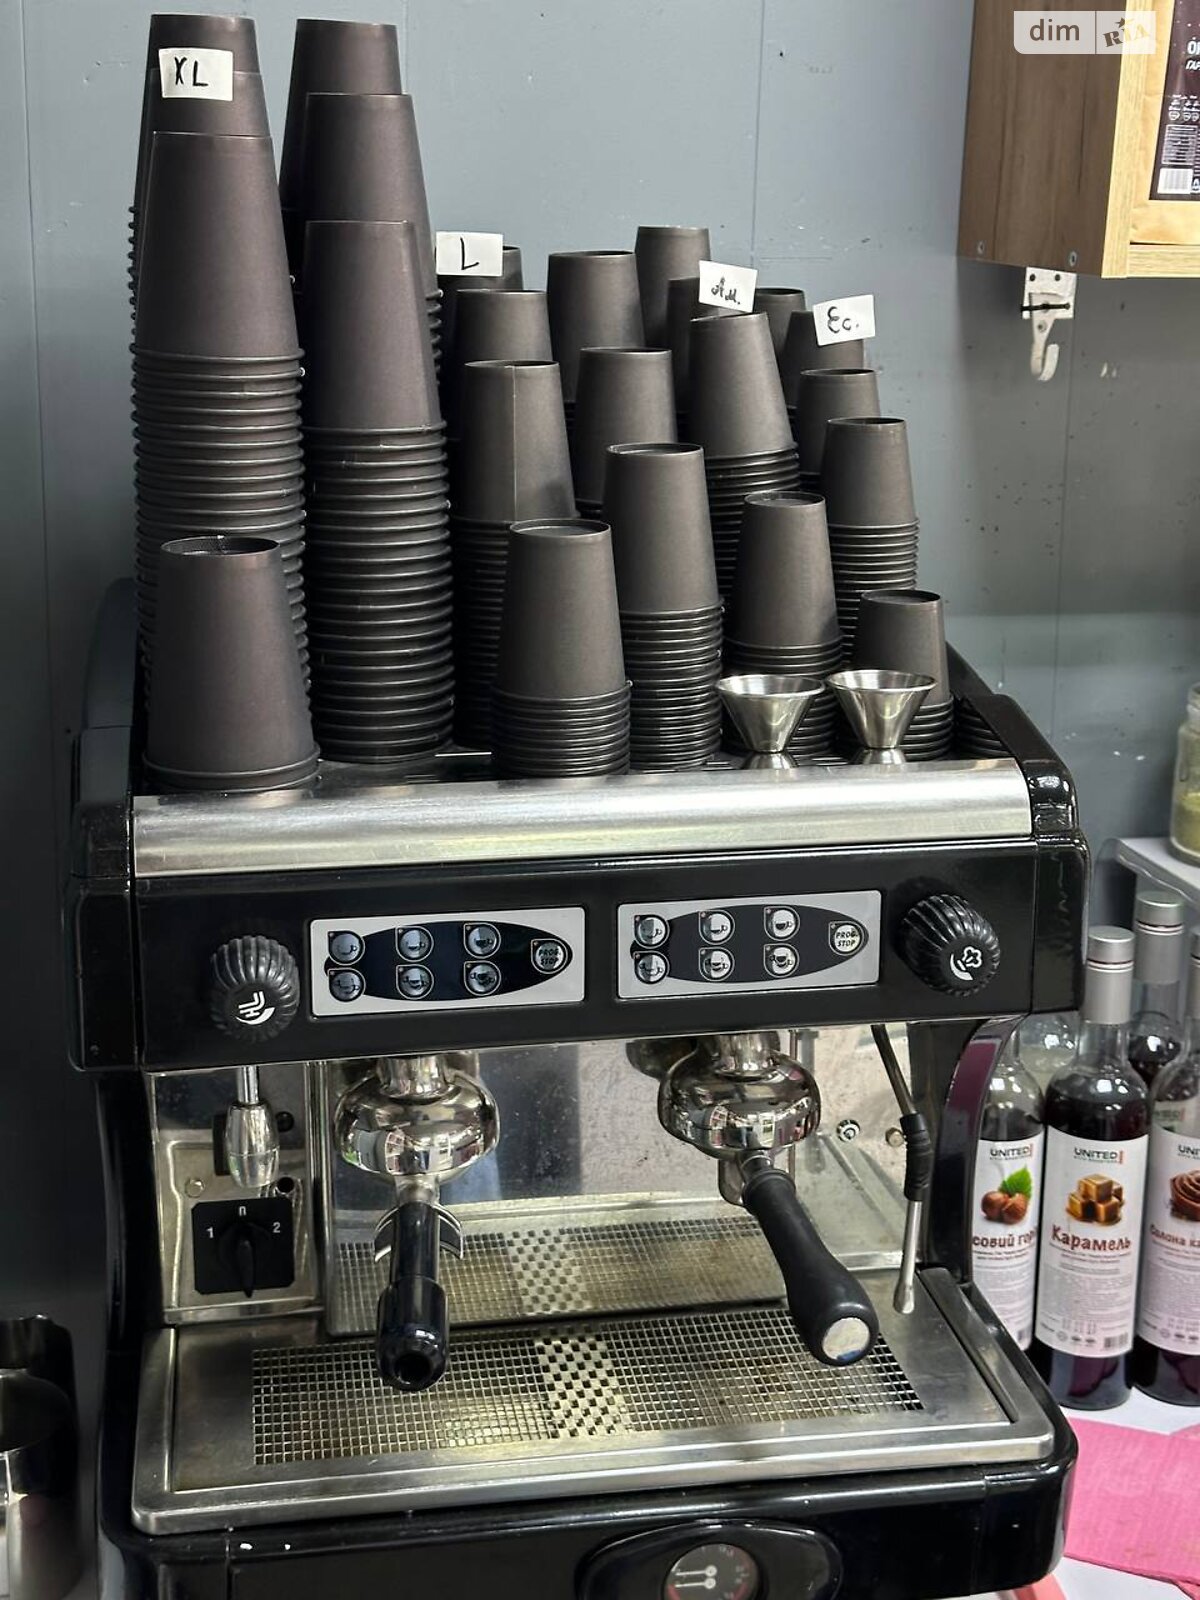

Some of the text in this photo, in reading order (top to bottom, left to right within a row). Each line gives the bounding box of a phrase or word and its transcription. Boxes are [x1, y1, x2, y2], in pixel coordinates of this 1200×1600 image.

[174, 56, 209, 86] XL
[459, 236, 480, 271] L
[1074, 1147, 1118, 1160] UNITED
[206, 1226, 214, 1239] 1
[273, 1221, 281, 1234] 2
[1052, 1223, 1131, 1251] Карамель
